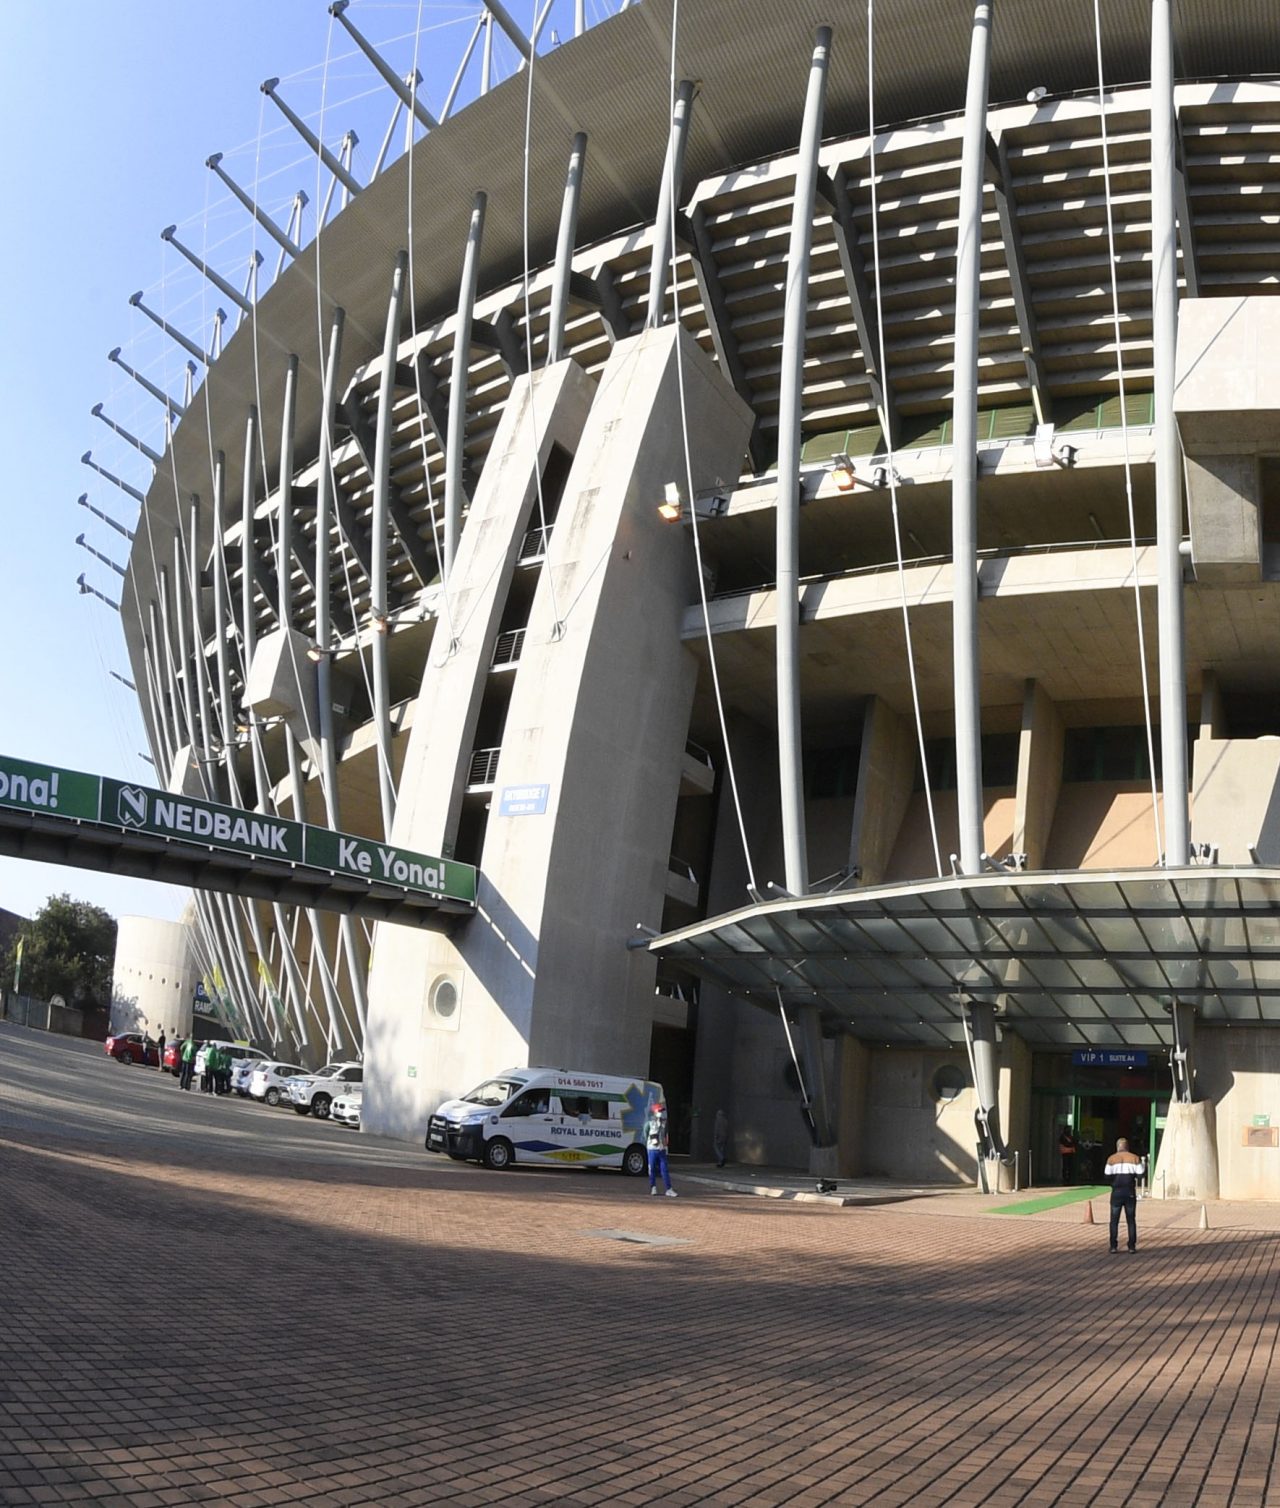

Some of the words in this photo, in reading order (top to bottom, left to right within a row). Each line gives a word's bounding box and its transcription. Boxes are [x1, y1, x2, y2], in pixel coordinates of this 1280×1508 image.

[155, 799, 288, 852] NEDBANK
[339, 838, 372, 873] Ke
[377, 847, 446, 890] Yona!
[1080, 1053, 1097, 1062] VIP
[1109, 1054, 1126, 1062] SUITE
[558, 1078, 572, 1086] 014
[550, 1126, 577, 1136] ROYAL
[579, 1128, 622, 1138] BAFOKENG
